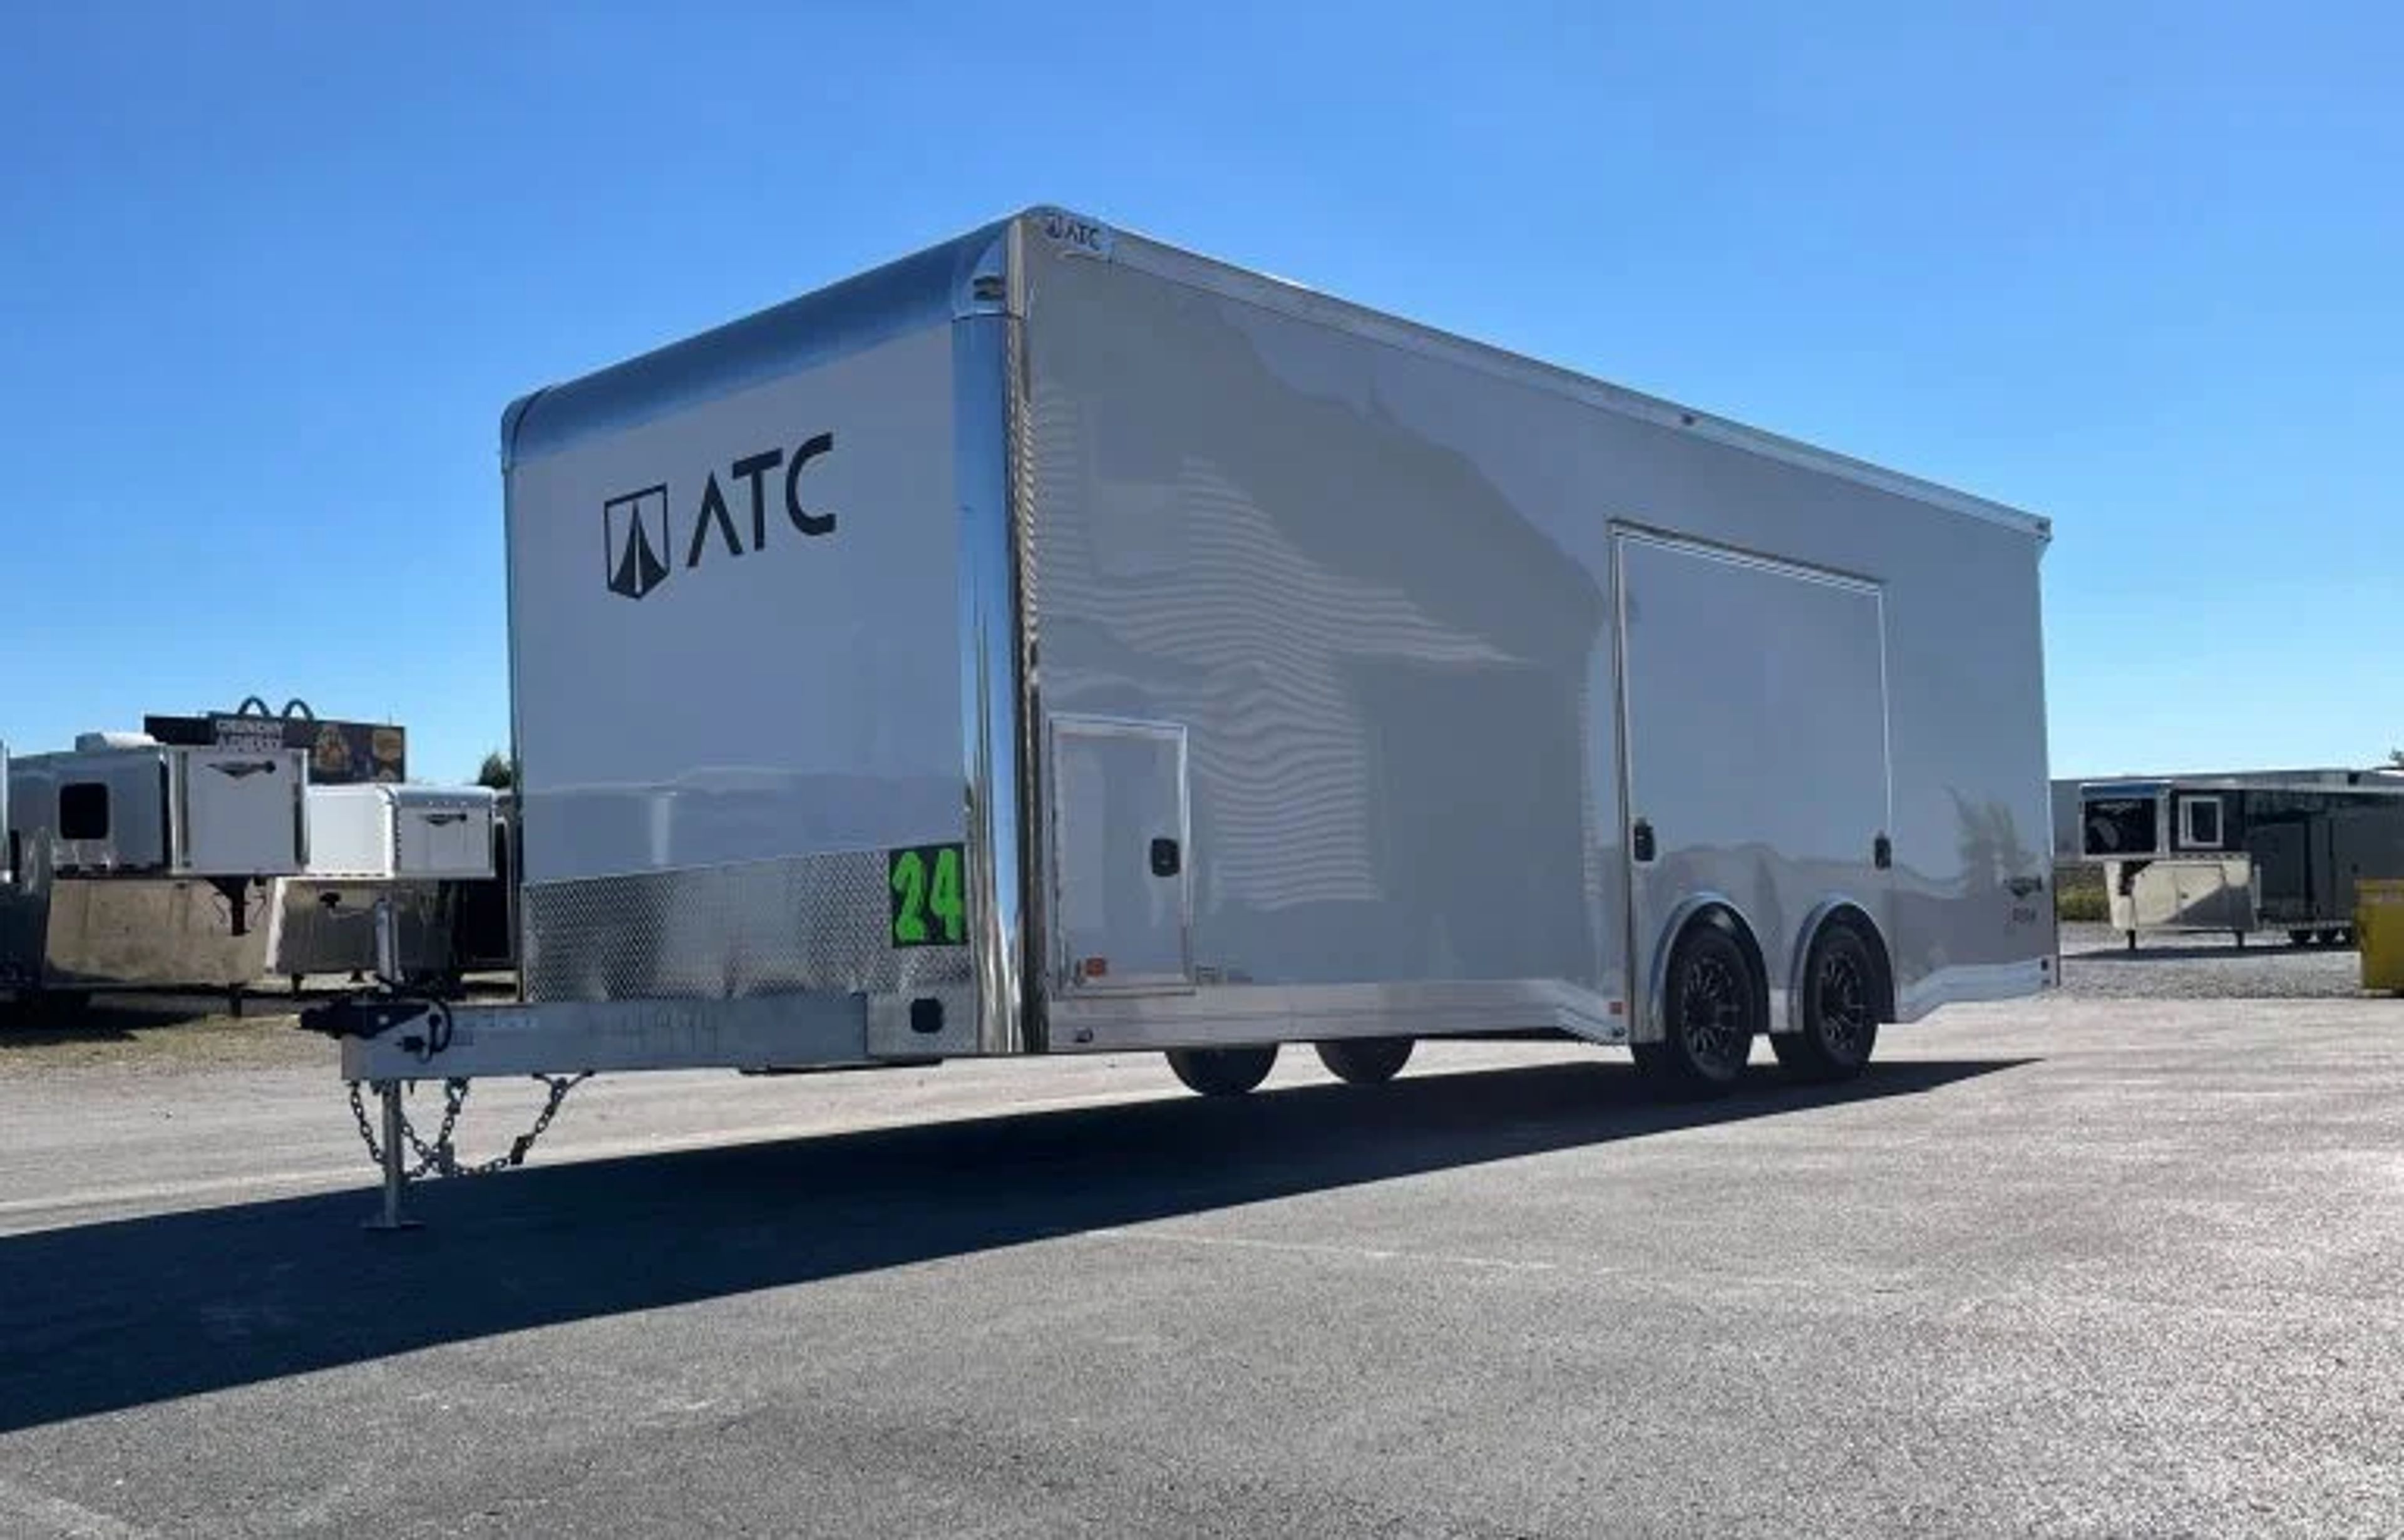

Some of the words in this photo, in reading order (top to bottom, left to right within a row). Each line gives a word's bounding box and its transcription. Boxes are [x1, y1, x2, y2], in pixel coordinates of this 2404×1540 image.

[1065, 222, 1100, 251] ATC
[687, 431, 836, 568] ATC
[892, 850, 963, 942] 24
